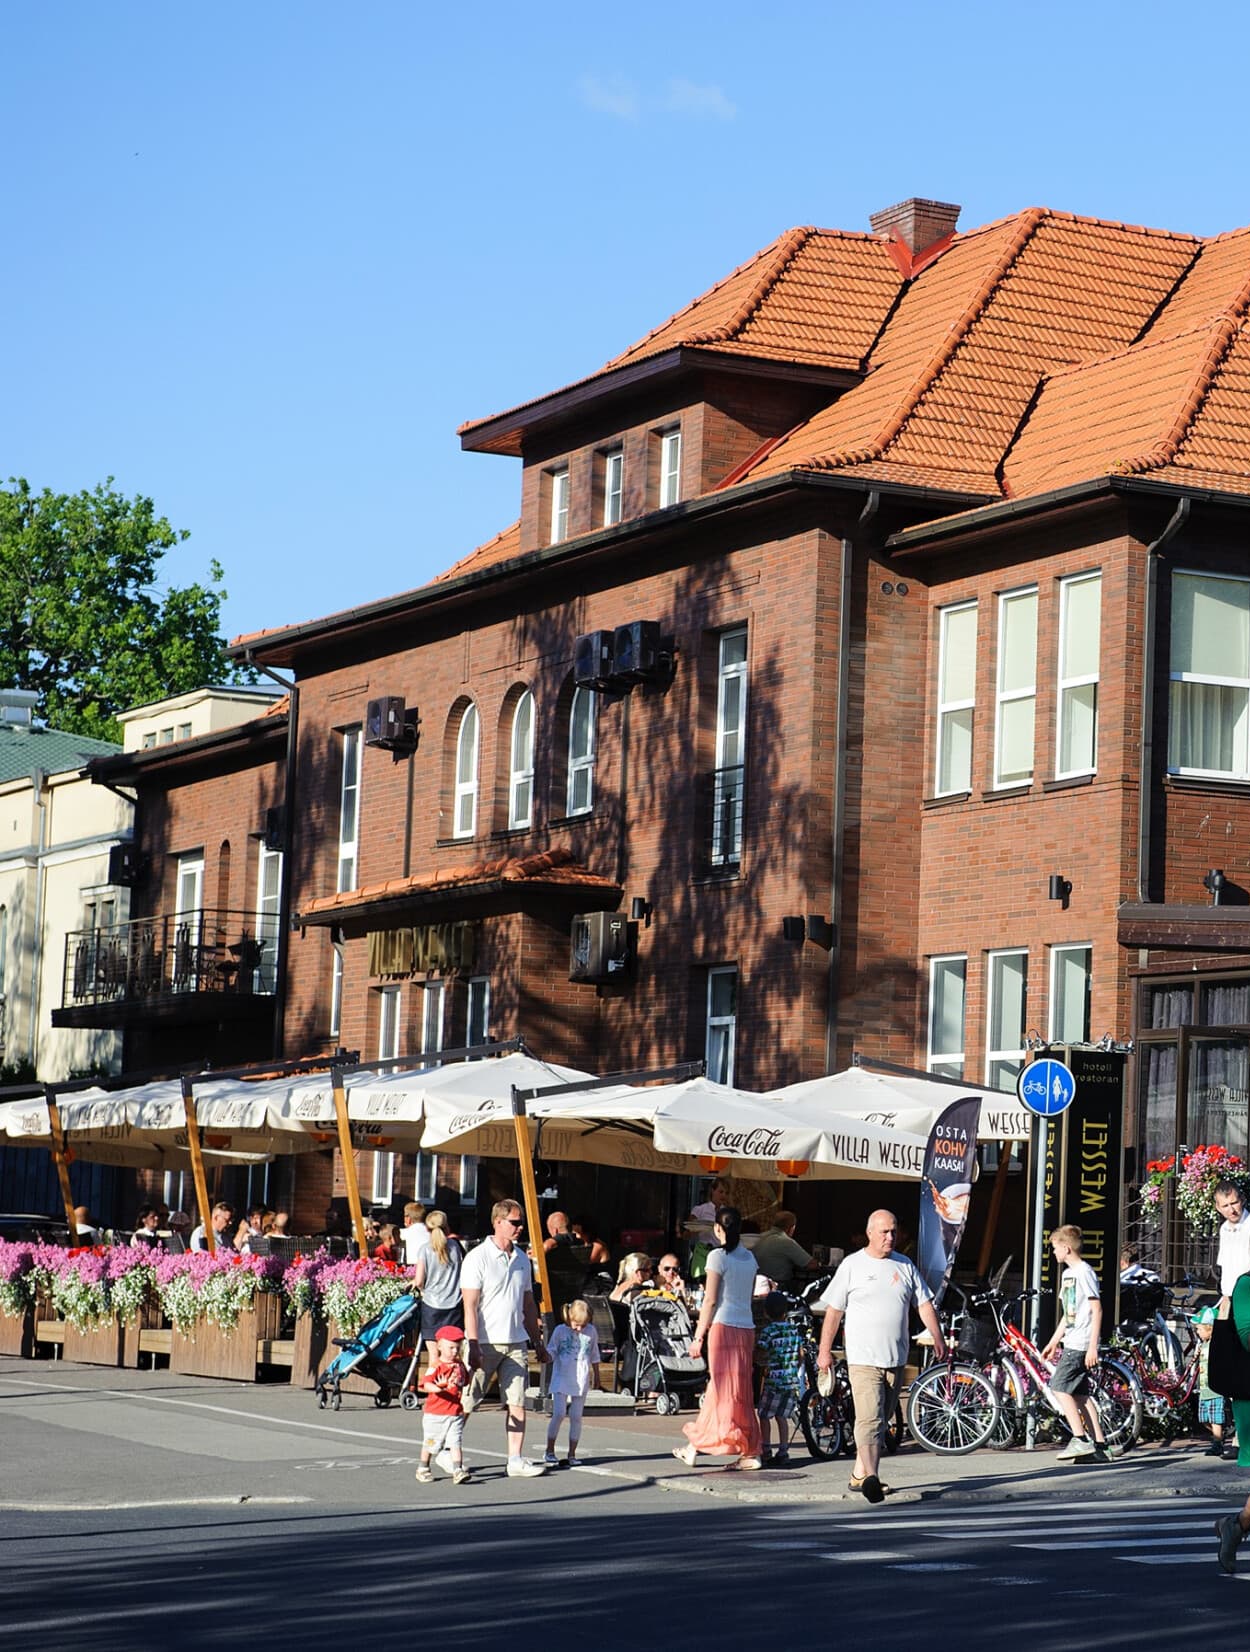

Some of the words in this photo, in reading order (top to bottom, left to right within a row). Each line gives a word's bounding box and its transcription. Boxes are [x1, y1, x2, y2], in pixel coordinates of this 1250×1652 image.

[1082, 1062, 1112, 1071] hotell
[1076, 1075, 1119, 1083] restoran
[936, 1125, 968, 1139] OSTA
[988, 1112, 1031, 1135] WESSE
[708, 1125, 784, 1157] Coca-Cola
[934, 1139, 967, 1158] KOHV
[833, 1134, 870, 1163] VILLA
[879, 1141, 926, 1171] WESSE
[934, 1156, 964, 1173] KAASA!
[1080, 1118, 1108, 1213] WESSET
